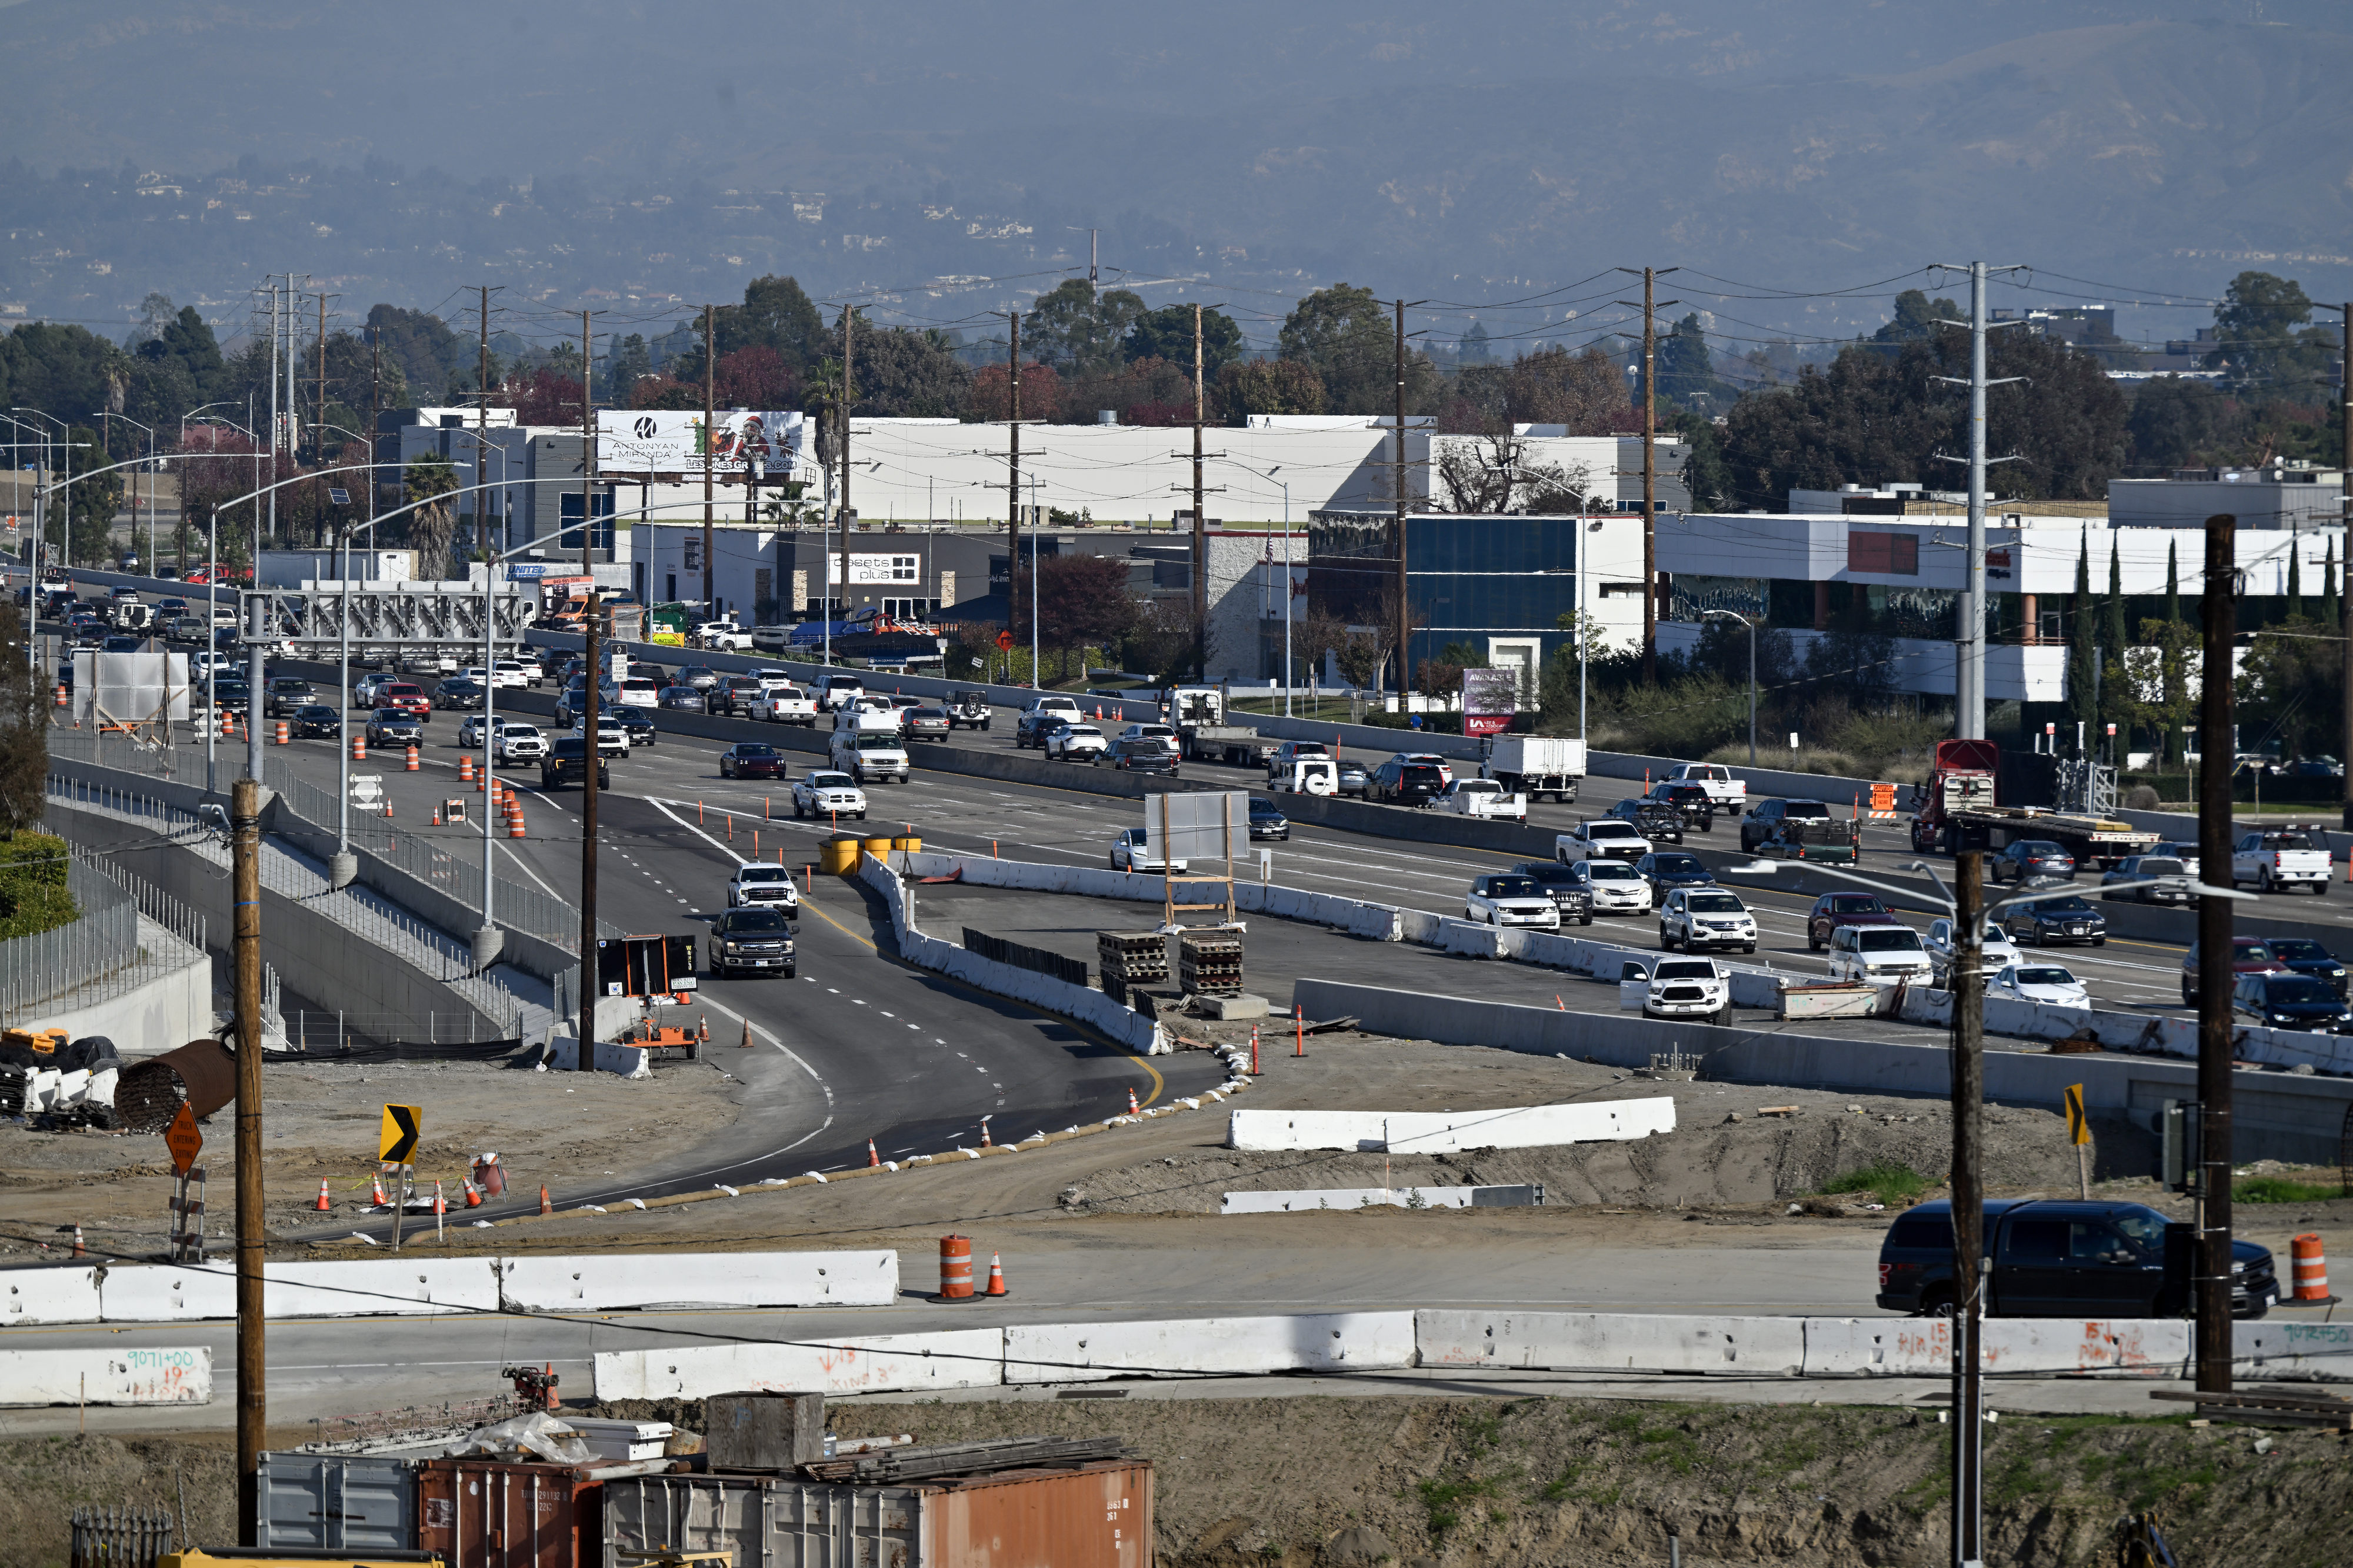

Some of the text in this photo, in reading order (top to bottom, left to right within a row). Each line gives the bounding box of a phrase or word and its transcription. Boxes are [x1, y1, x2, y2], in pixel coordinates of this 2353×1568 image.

[508, 565, 546, 573] UNITED
[860, 569, 889, 581] plus
[178, 1120, 192, 1130] TRUCK
[174, 1135, 196, 1145] ENTERING
[175, 1149, 193, 1159] EXITING
[2284, 1323, 2349, 1343] 9072+50
[128, 1351, 193, 1369] 9071+00
[539, 1491, 560, 1500] 291132
